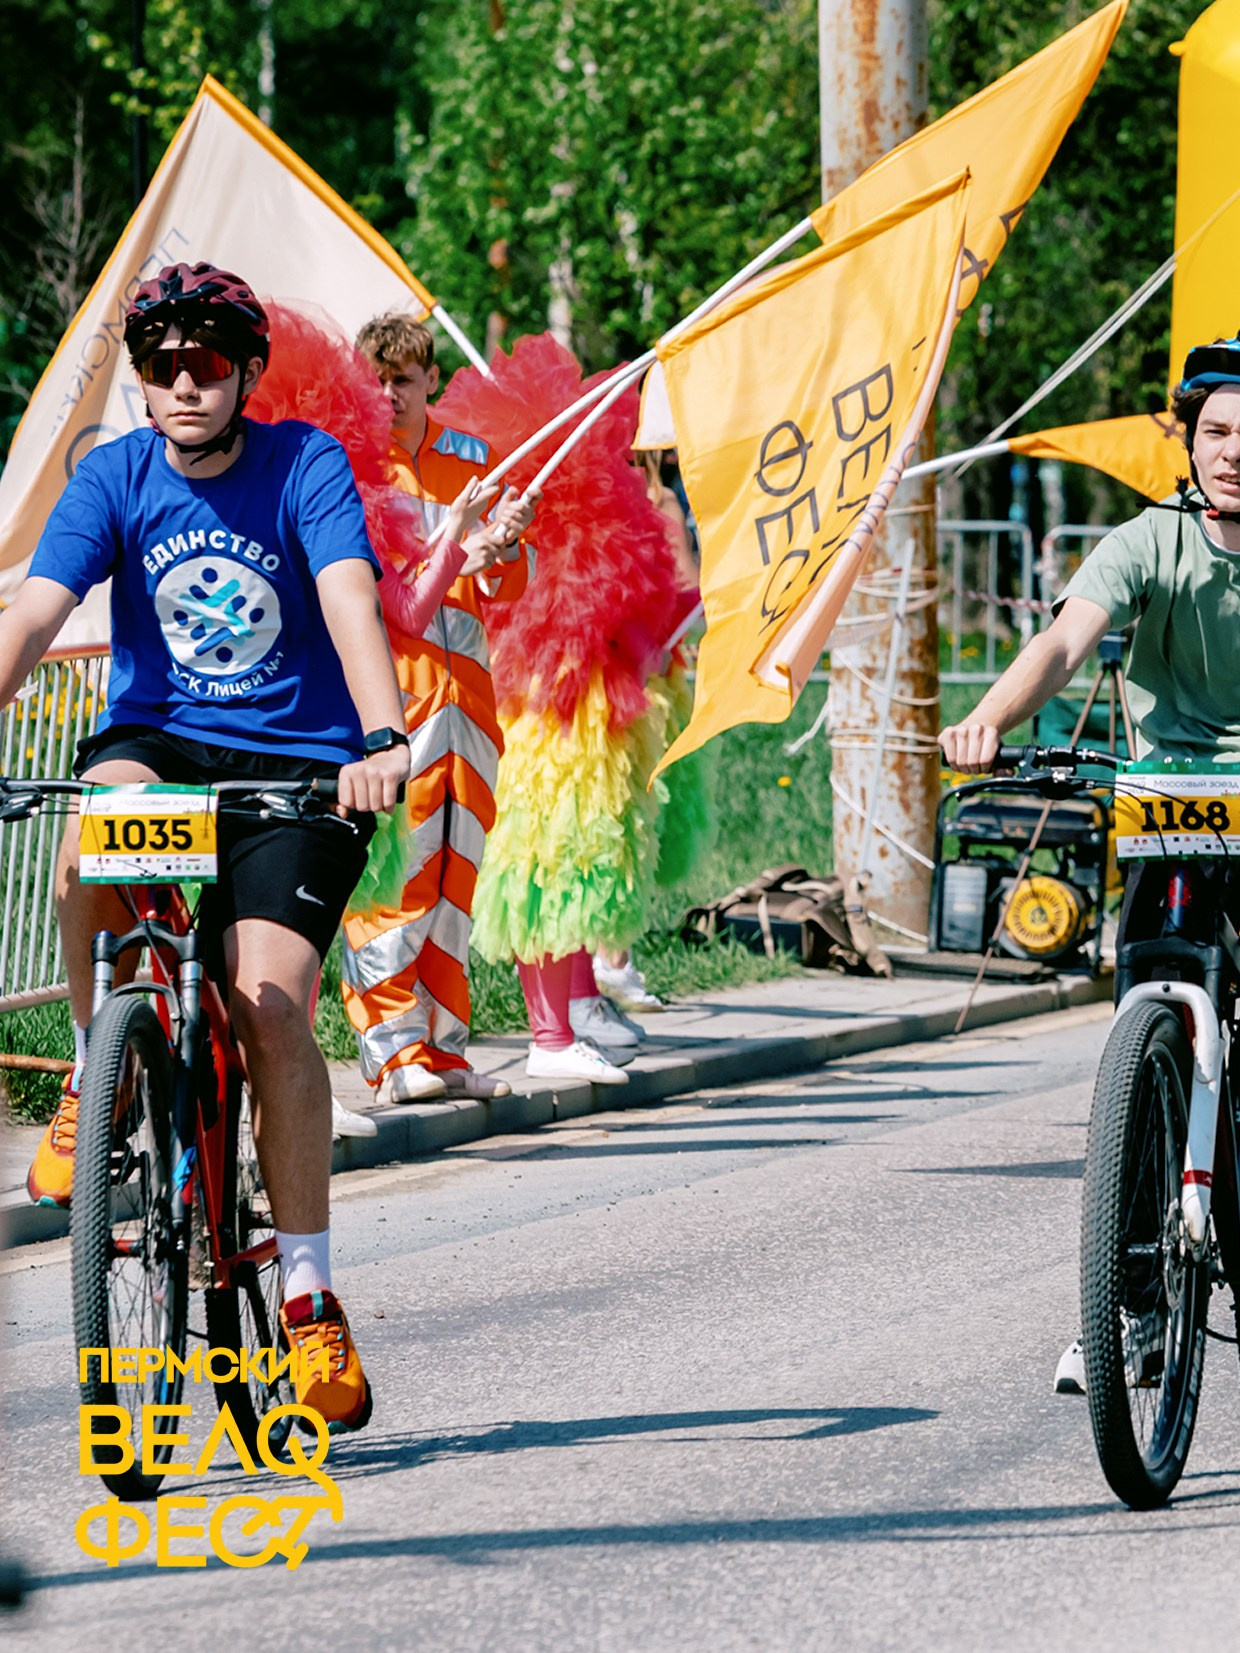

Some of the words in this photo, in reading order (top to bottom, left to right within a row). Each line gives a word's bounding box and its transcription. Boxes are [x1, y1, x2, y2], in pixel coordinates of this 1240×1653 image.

[753, 420, 814, 637] ФЕС
[142, 529, 281, 576] ЕДИНСТВО
[205, 672, 265, 698] Лицей
[1141, 800, 1231, 832] 1168
[103, 818, 193, 851] 1035
